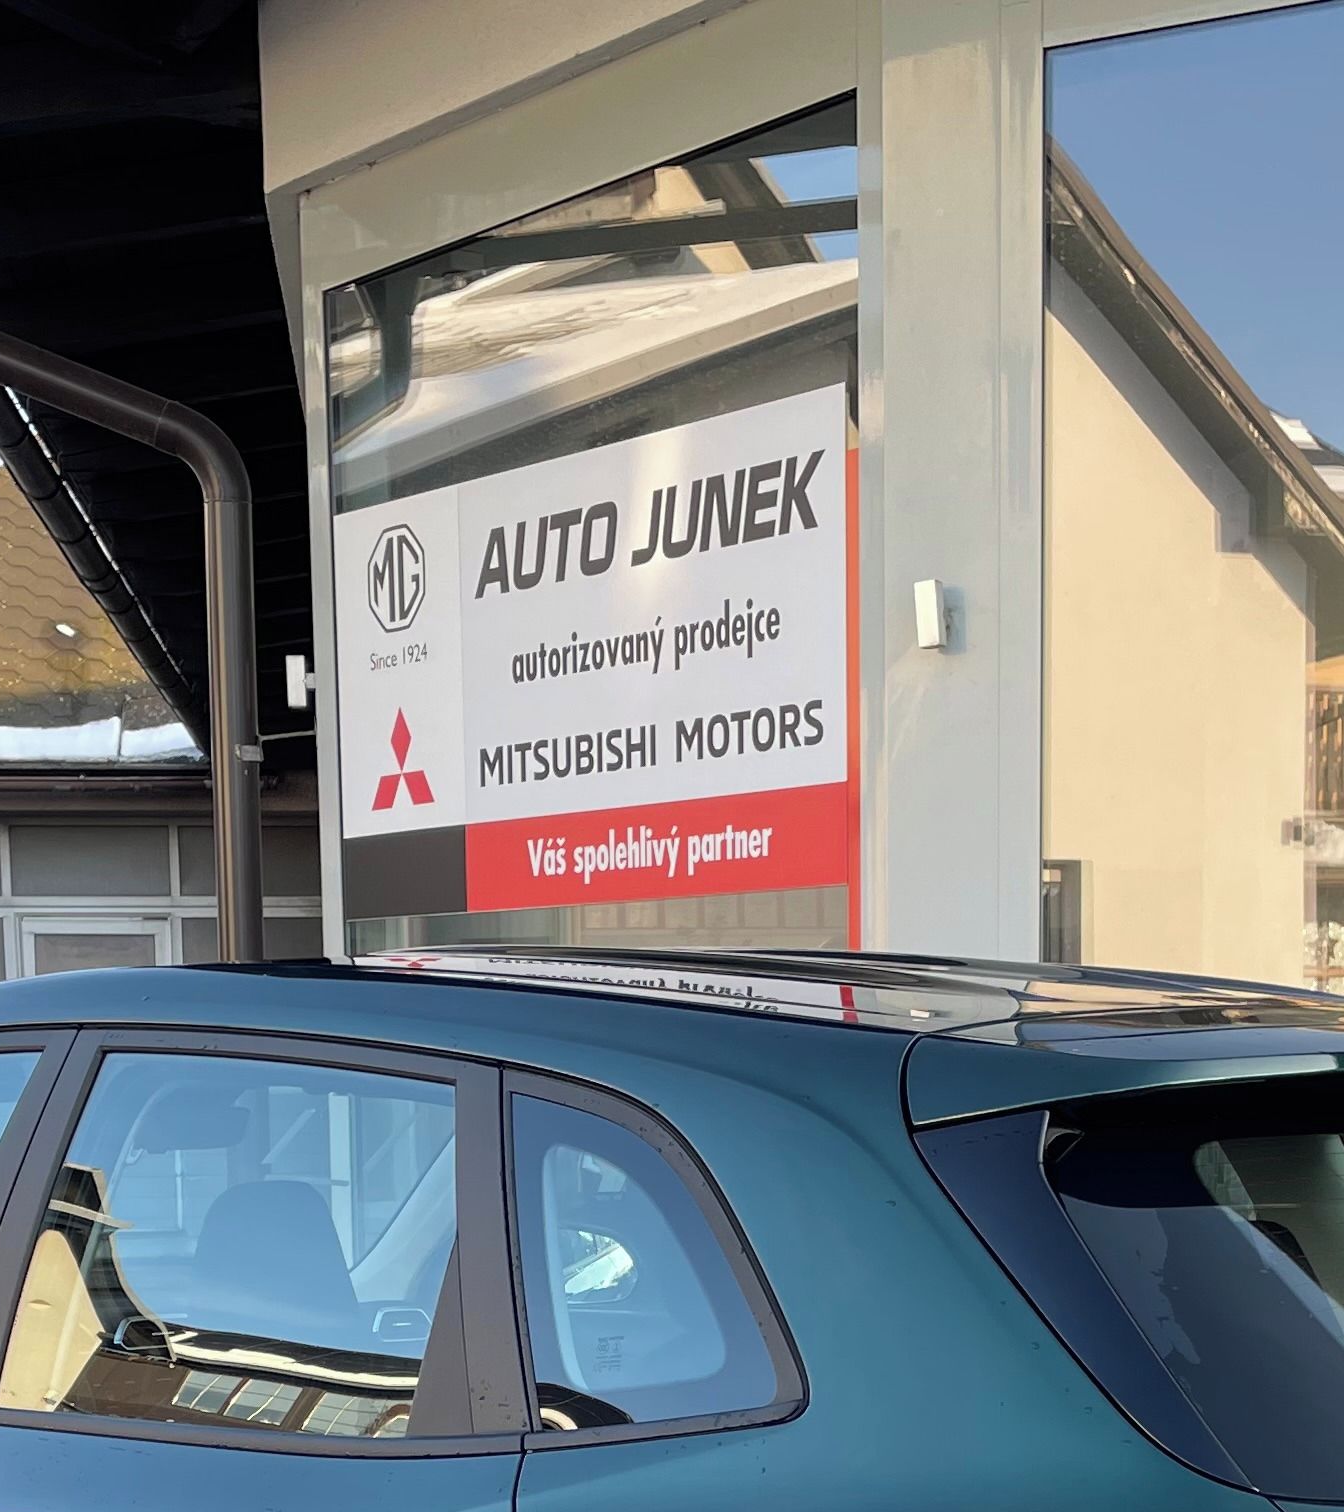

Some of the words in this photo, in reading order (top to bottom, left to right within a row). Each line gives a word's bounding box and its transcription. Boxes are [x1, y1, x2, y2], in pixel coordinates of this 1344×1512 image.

[475, 501, 618, 600] AUTO
[631, 449, 826, 567] JUNEK
[370, 529, 423, 628] MG
[369, 651, 398, 671] Since
[401, 642, 428, 665] 1924
[512, 616, 664, 685] autorizovaný
[674, 598, 781, 670] prodejce
[479, 724, 657, 788] MITSUBISHI
[675, 699, 824, 762] MOTORS
[527, 836, 567, 877] Váš
[573, 825, 681, 885] spolehlivý
[687, 825, 773, 876] partner
